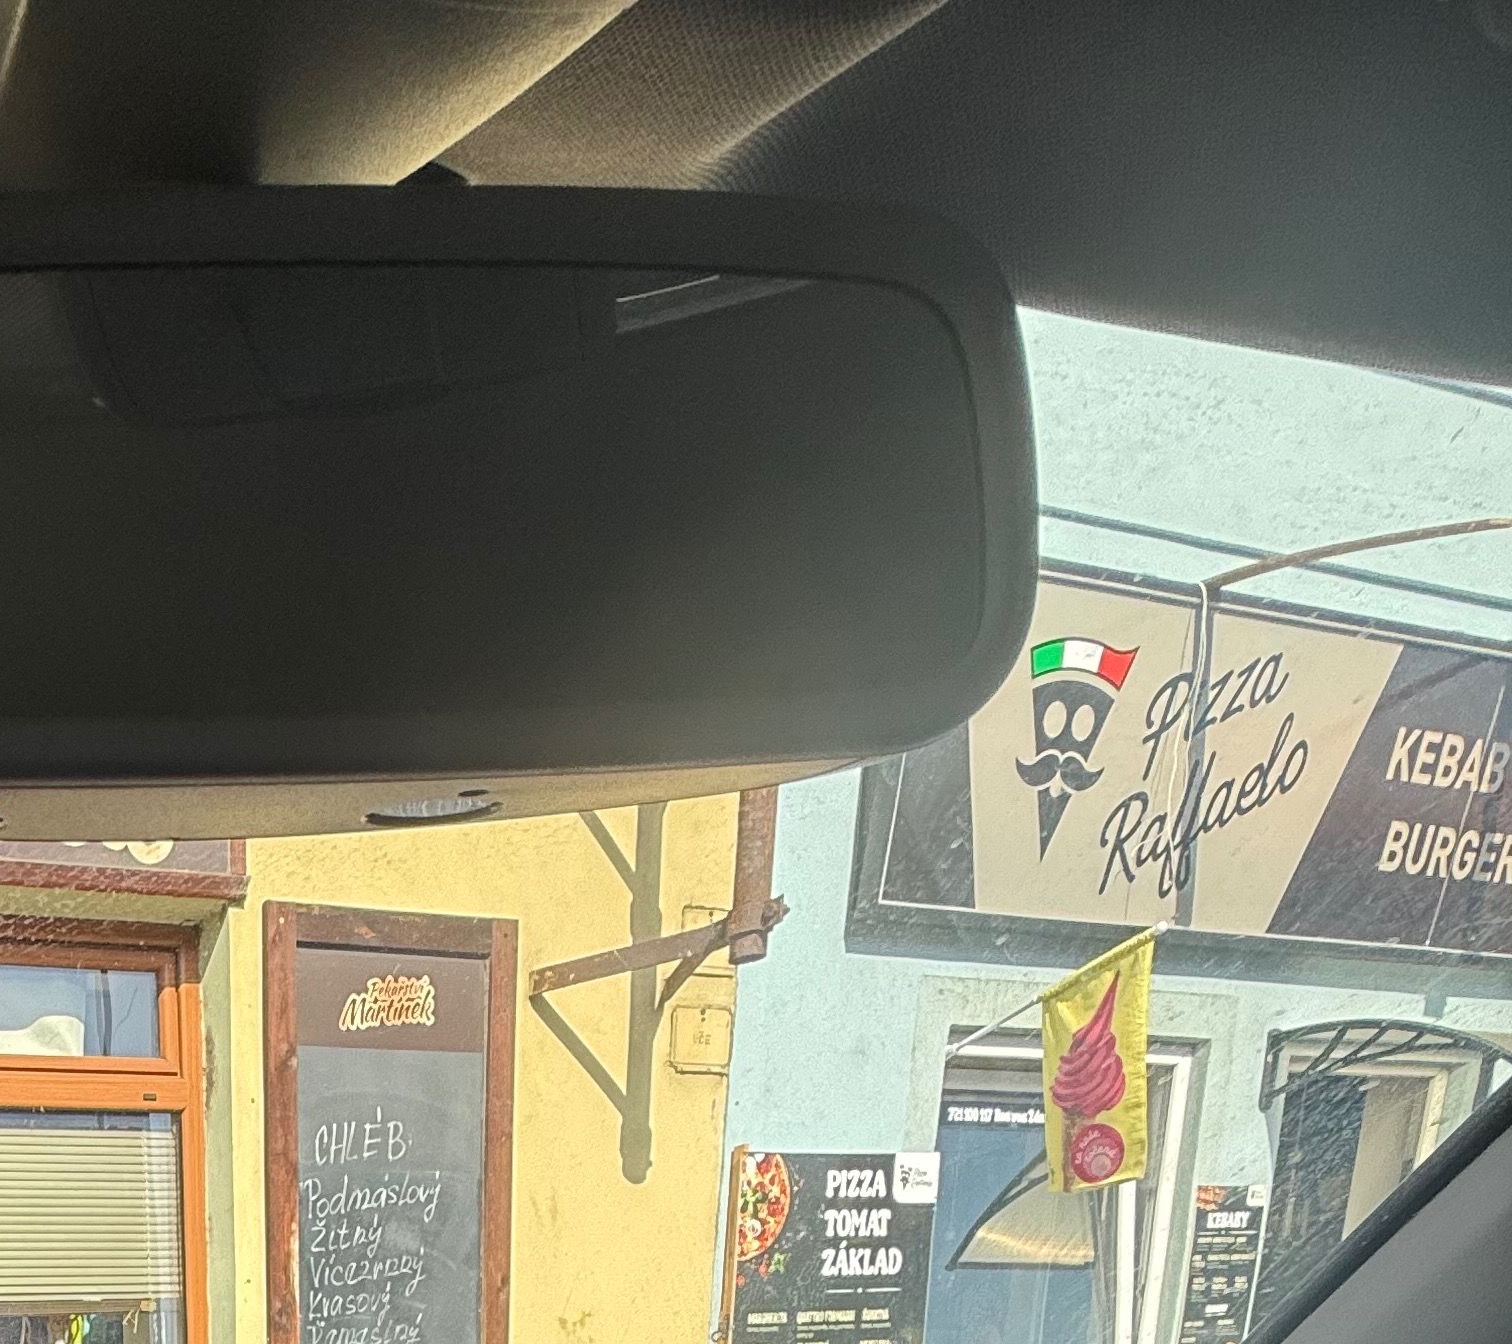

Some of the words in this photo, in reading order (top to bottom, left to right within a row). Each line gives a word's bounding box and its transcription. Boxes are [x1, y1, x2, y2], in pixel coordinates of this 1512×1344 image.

[1386, 726, 1510, 793] KEBAB
[342, 989, 431, 1026] Martínek
[825, 1169, 887, 1198] PIZZA
[824, 1208, 892, 1237] TOMAT
[821, 1240, 903, 1277] ZÁKLAD
